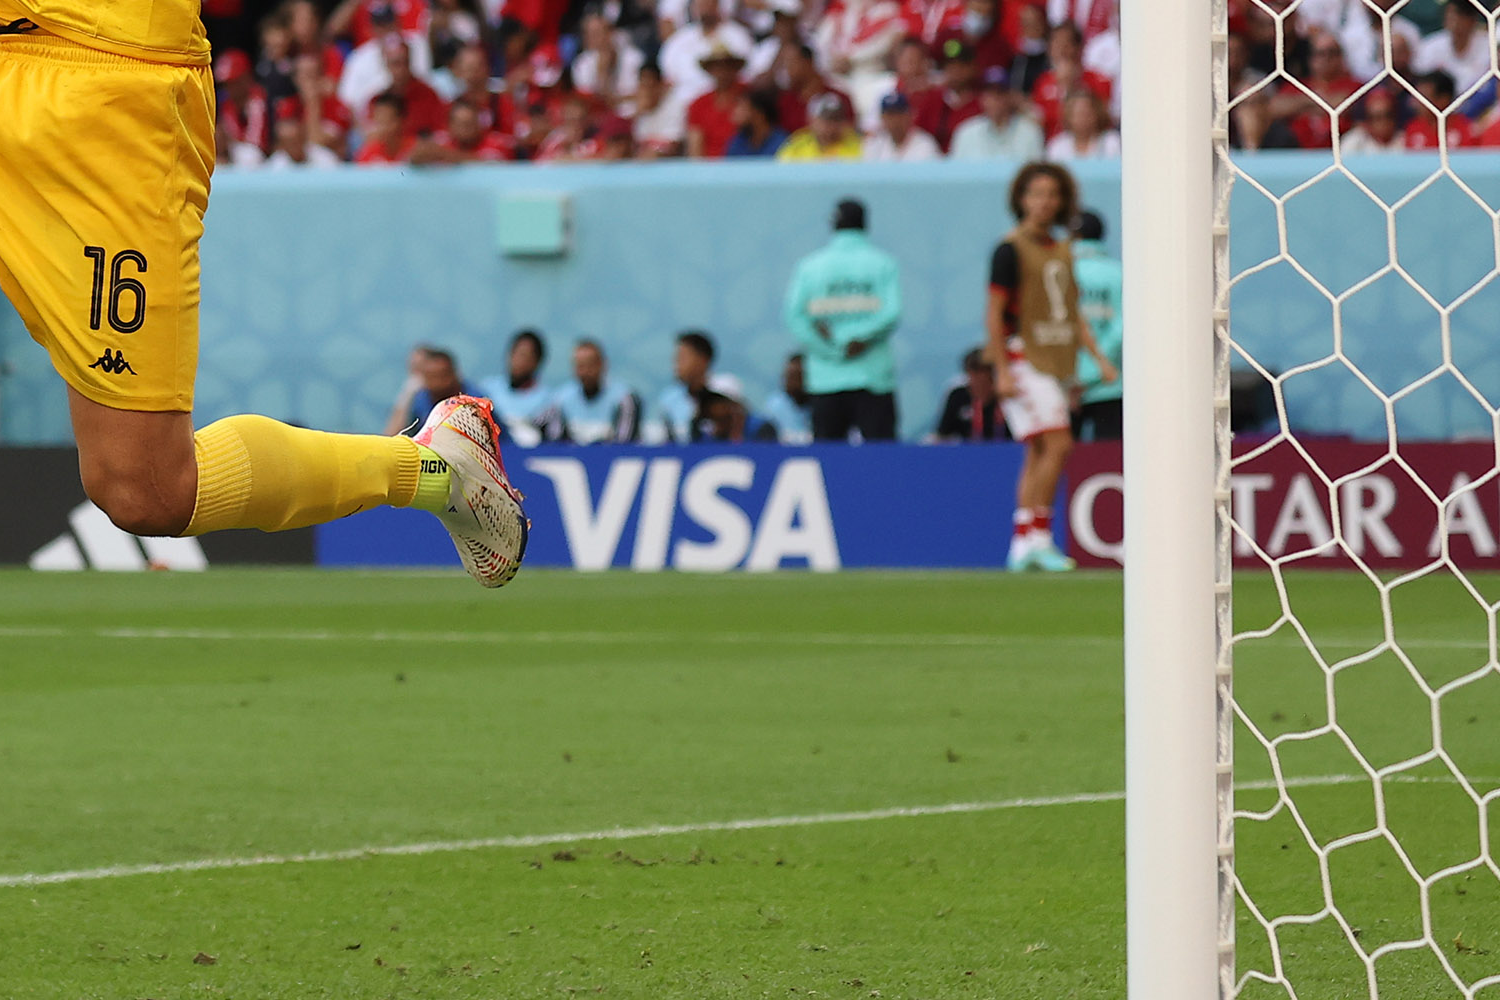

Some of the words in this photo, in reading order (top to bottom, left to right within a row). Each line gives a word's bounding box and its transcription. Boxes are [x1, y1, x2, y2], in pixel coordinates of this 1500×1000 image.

[83, 245, 148, 334] 16
[525, 455, 842, 572] VISA
[1069, 472, 1404, 567] QTAR
[1426, 471, 1500, 558] A
